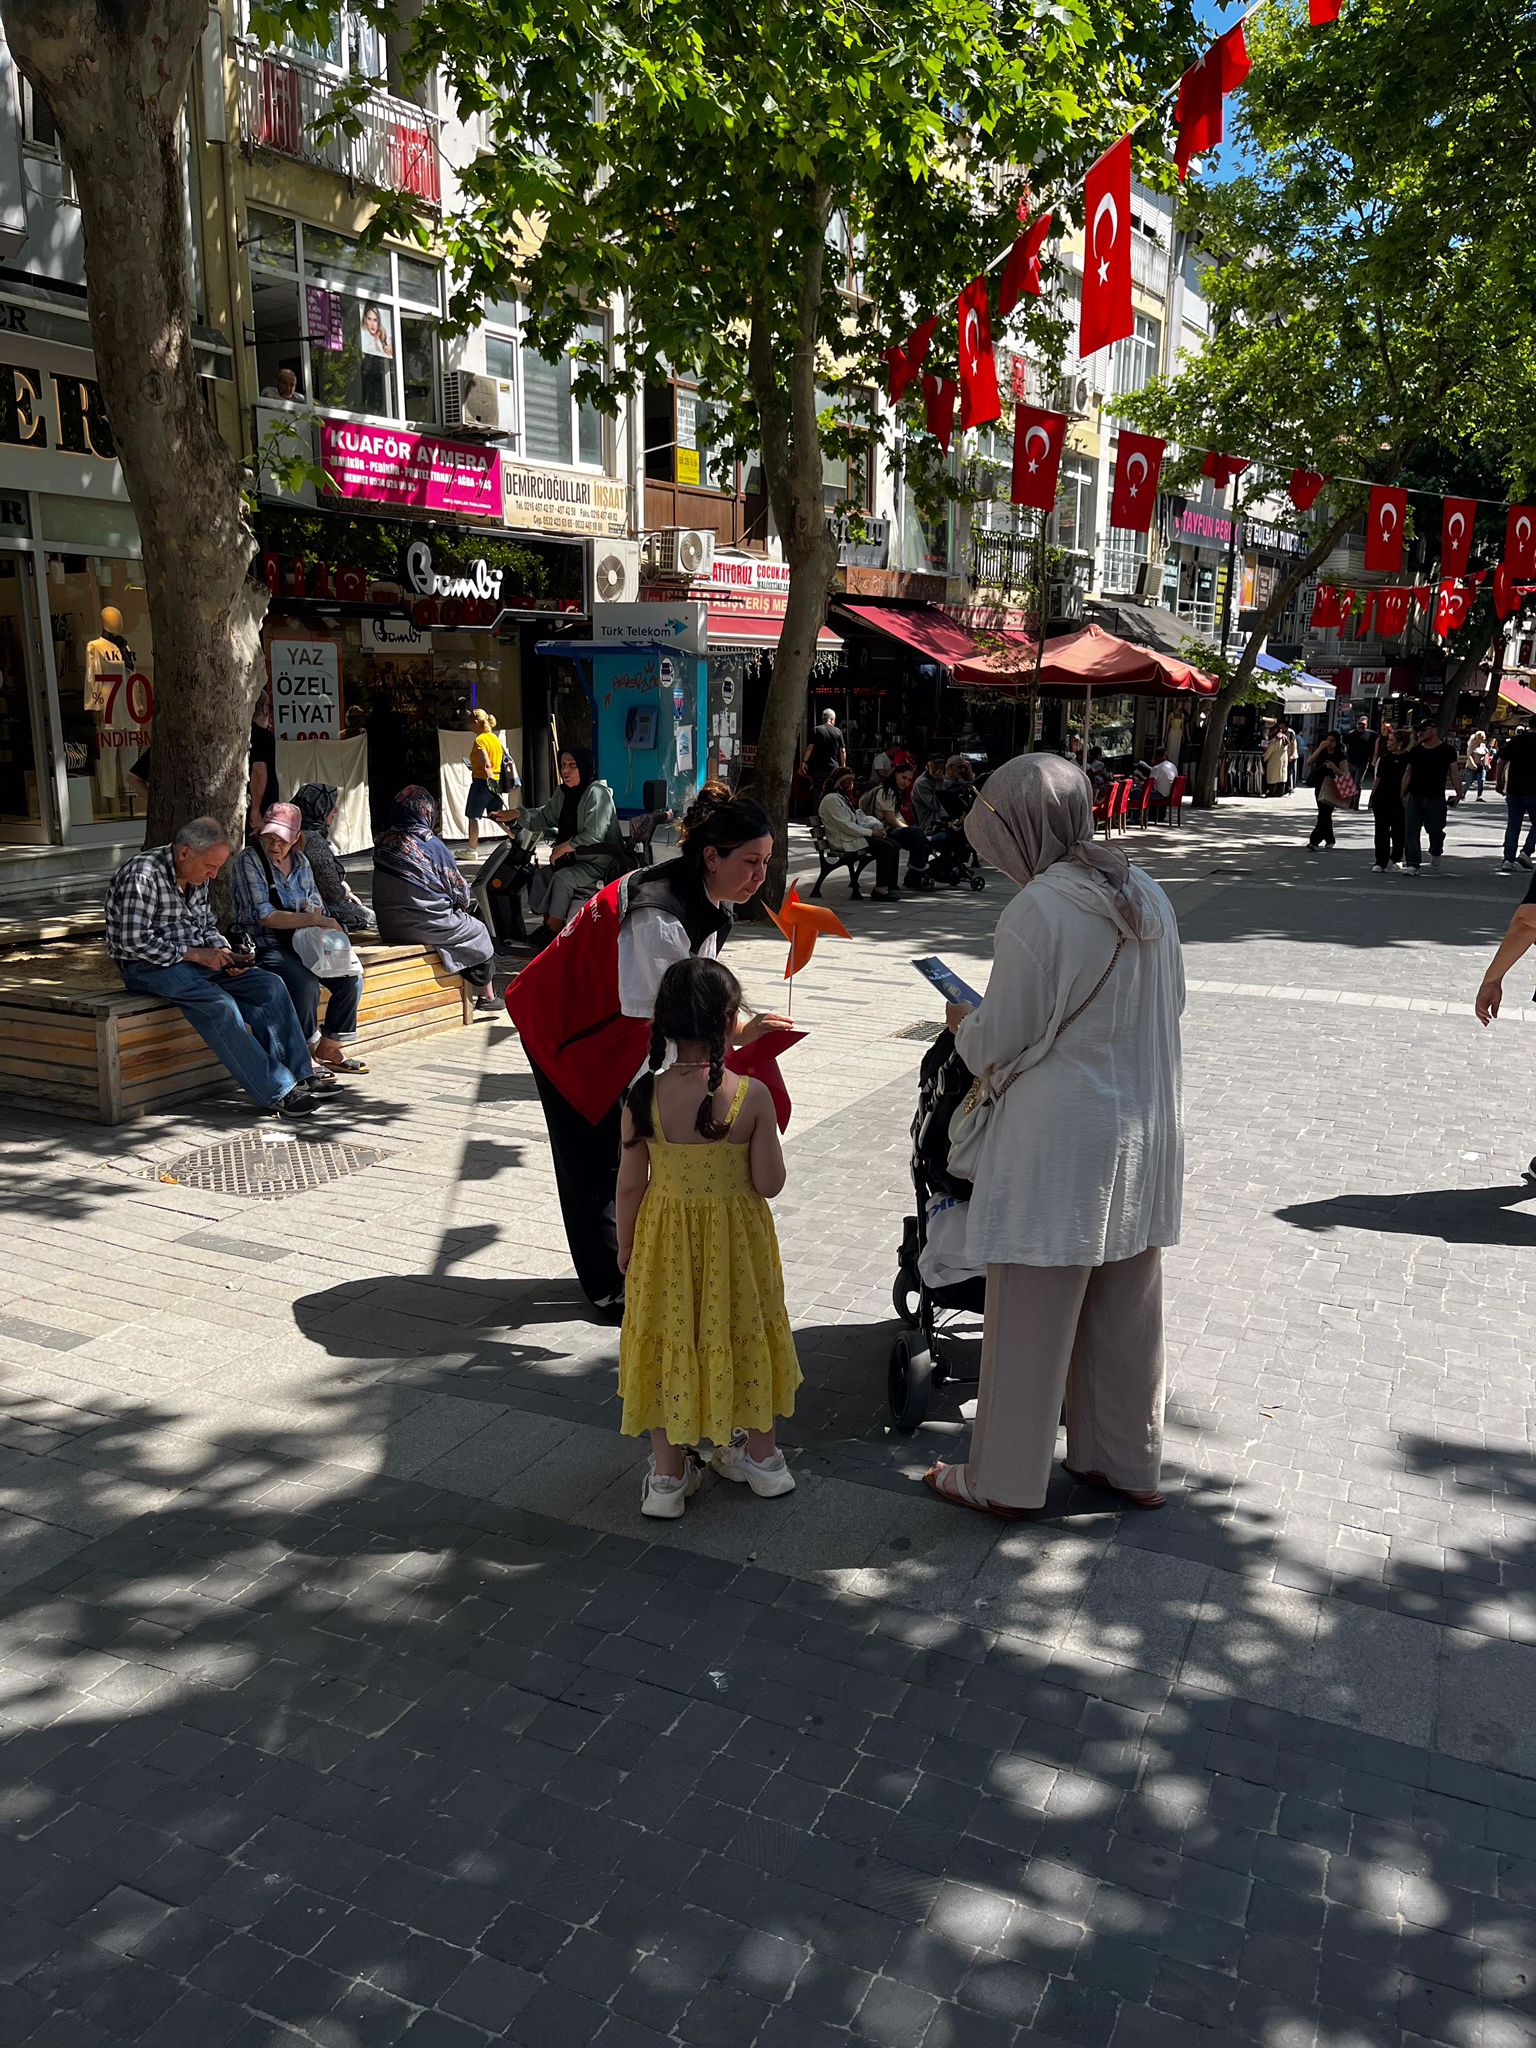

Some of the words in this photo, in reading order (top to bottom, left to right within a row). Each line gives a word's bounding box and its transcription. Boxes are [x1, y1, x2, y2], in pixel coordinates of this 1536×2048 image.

[331, 429, 411, 460] KUAFÖR
[416, 445, 489, 473] AYMERA
[505, 470, 591, 505] DEMİRCİOĞULLARI
[593, 480, 625, 510] İNŞAAT
[1183, 510, 1213, 536] TAYFUN
[407, 541, 504, 601] Bambi
[372, 618, 422, 644] Bambi
[601, 625, 624, 636] Türk
[627, 626, 671, 637] Telekom
[104, 650, 137, 661] AKR
[287, 647, 324, 666] YAZ
[276, 671, 333, 696] ÖZEL
[1360, 671, 1386, 685] ECZANE
[278, 700, 336, 724] FİYAT
